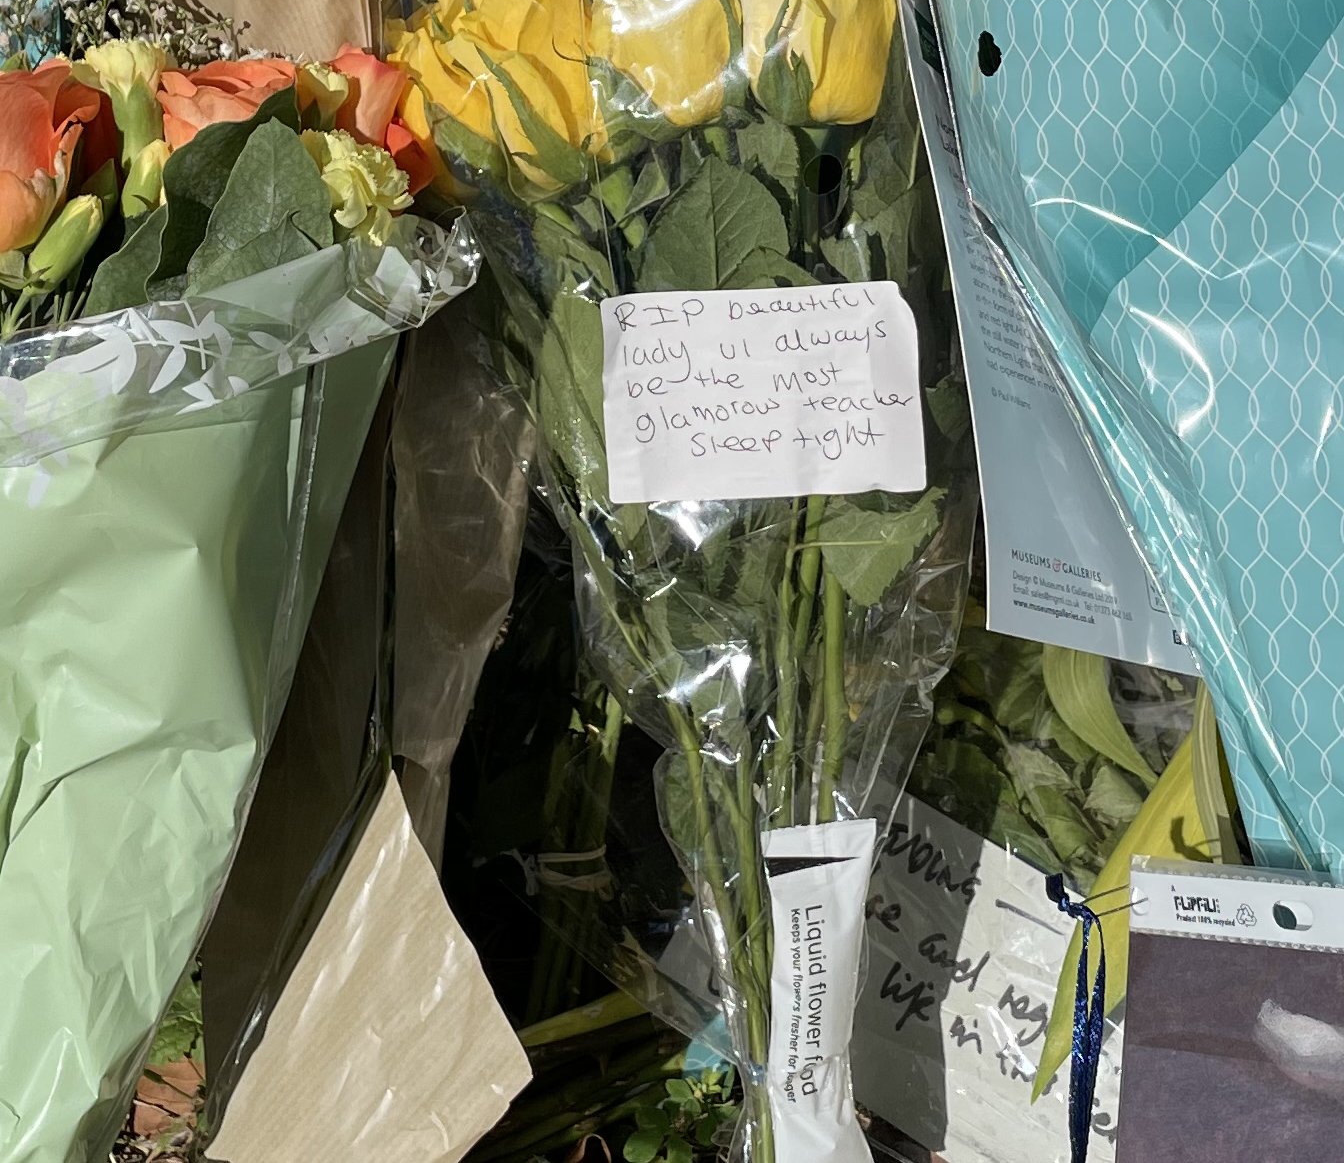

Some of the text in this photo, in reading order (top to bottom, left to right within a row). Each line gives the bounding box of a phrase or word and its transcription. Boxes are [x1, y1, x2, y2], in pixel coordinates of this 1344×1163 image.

[614, 288, 875, 331] RIP beautiful
[623, 340, 691, 383] lady
[775, 320, 887, 354] always
[628, 376, 668, 399] be
[694, 368, 744, 389] the
[803, 388, 915, 414] teacher
[793, 417, 886, 460] tight
[1011, 549, 1051, 569] MUSEUMS
[1062, 564, 1102, 582] GALLERIES
[790, 908, 802, 944] Keeps
[804, 904, 827, 976] Liquid
[791, 945, 802, 967] your
[791, 974, 804, 1013] flowers
[788, 1013, 803, 1053] fresher
[806, 983, 827, 1049] flower
[788, 1053, 799, 1070] for
